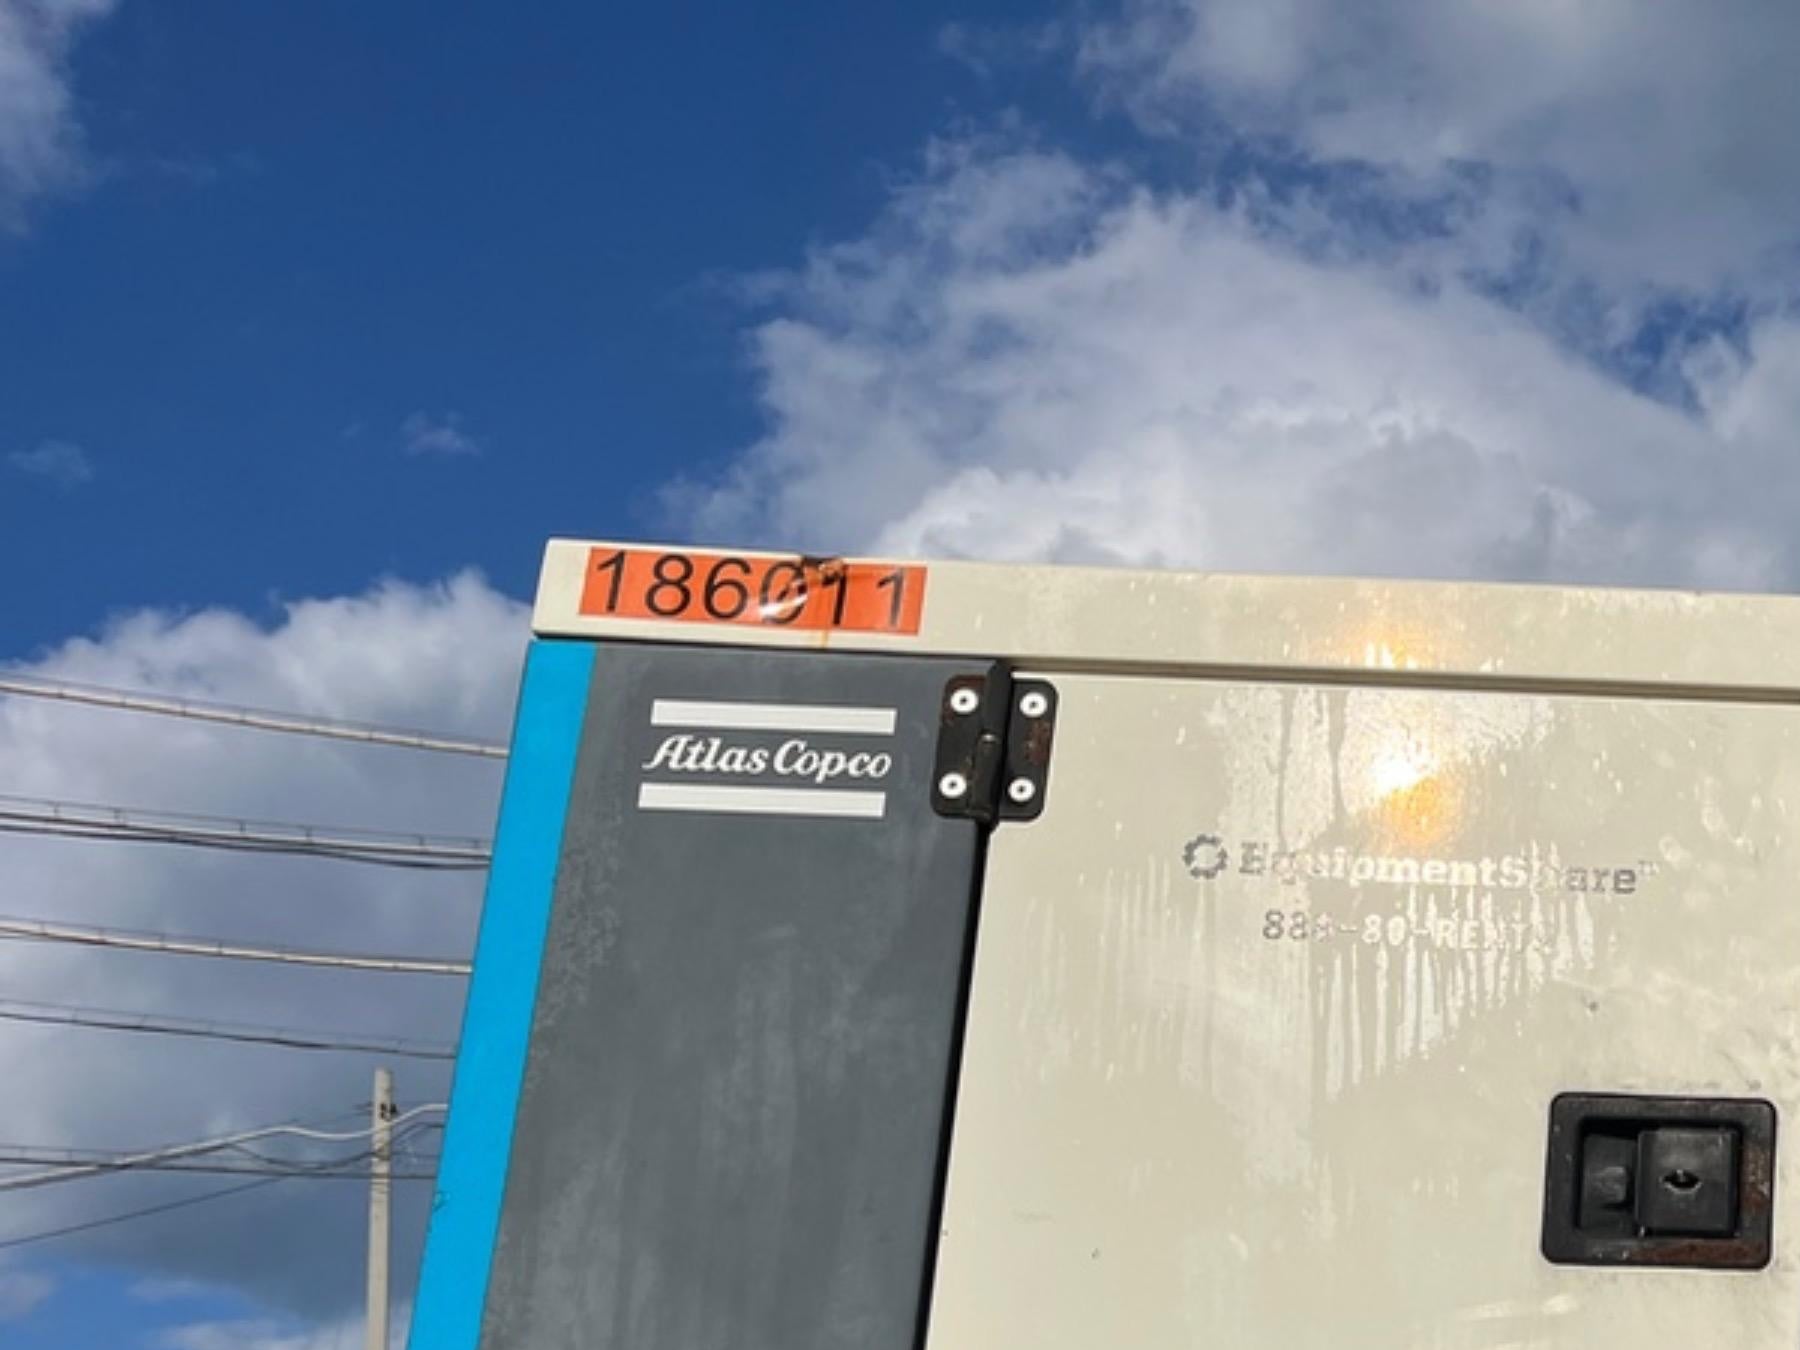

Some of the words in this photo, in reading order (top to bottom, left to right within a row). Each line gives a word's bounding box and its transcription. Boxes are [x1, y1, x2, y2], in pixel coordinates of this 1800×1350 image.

[597, 550, 905, 628] 186011
[641, 733, 770, 775] Atlas
[772, 739, 893, 785] Copco
